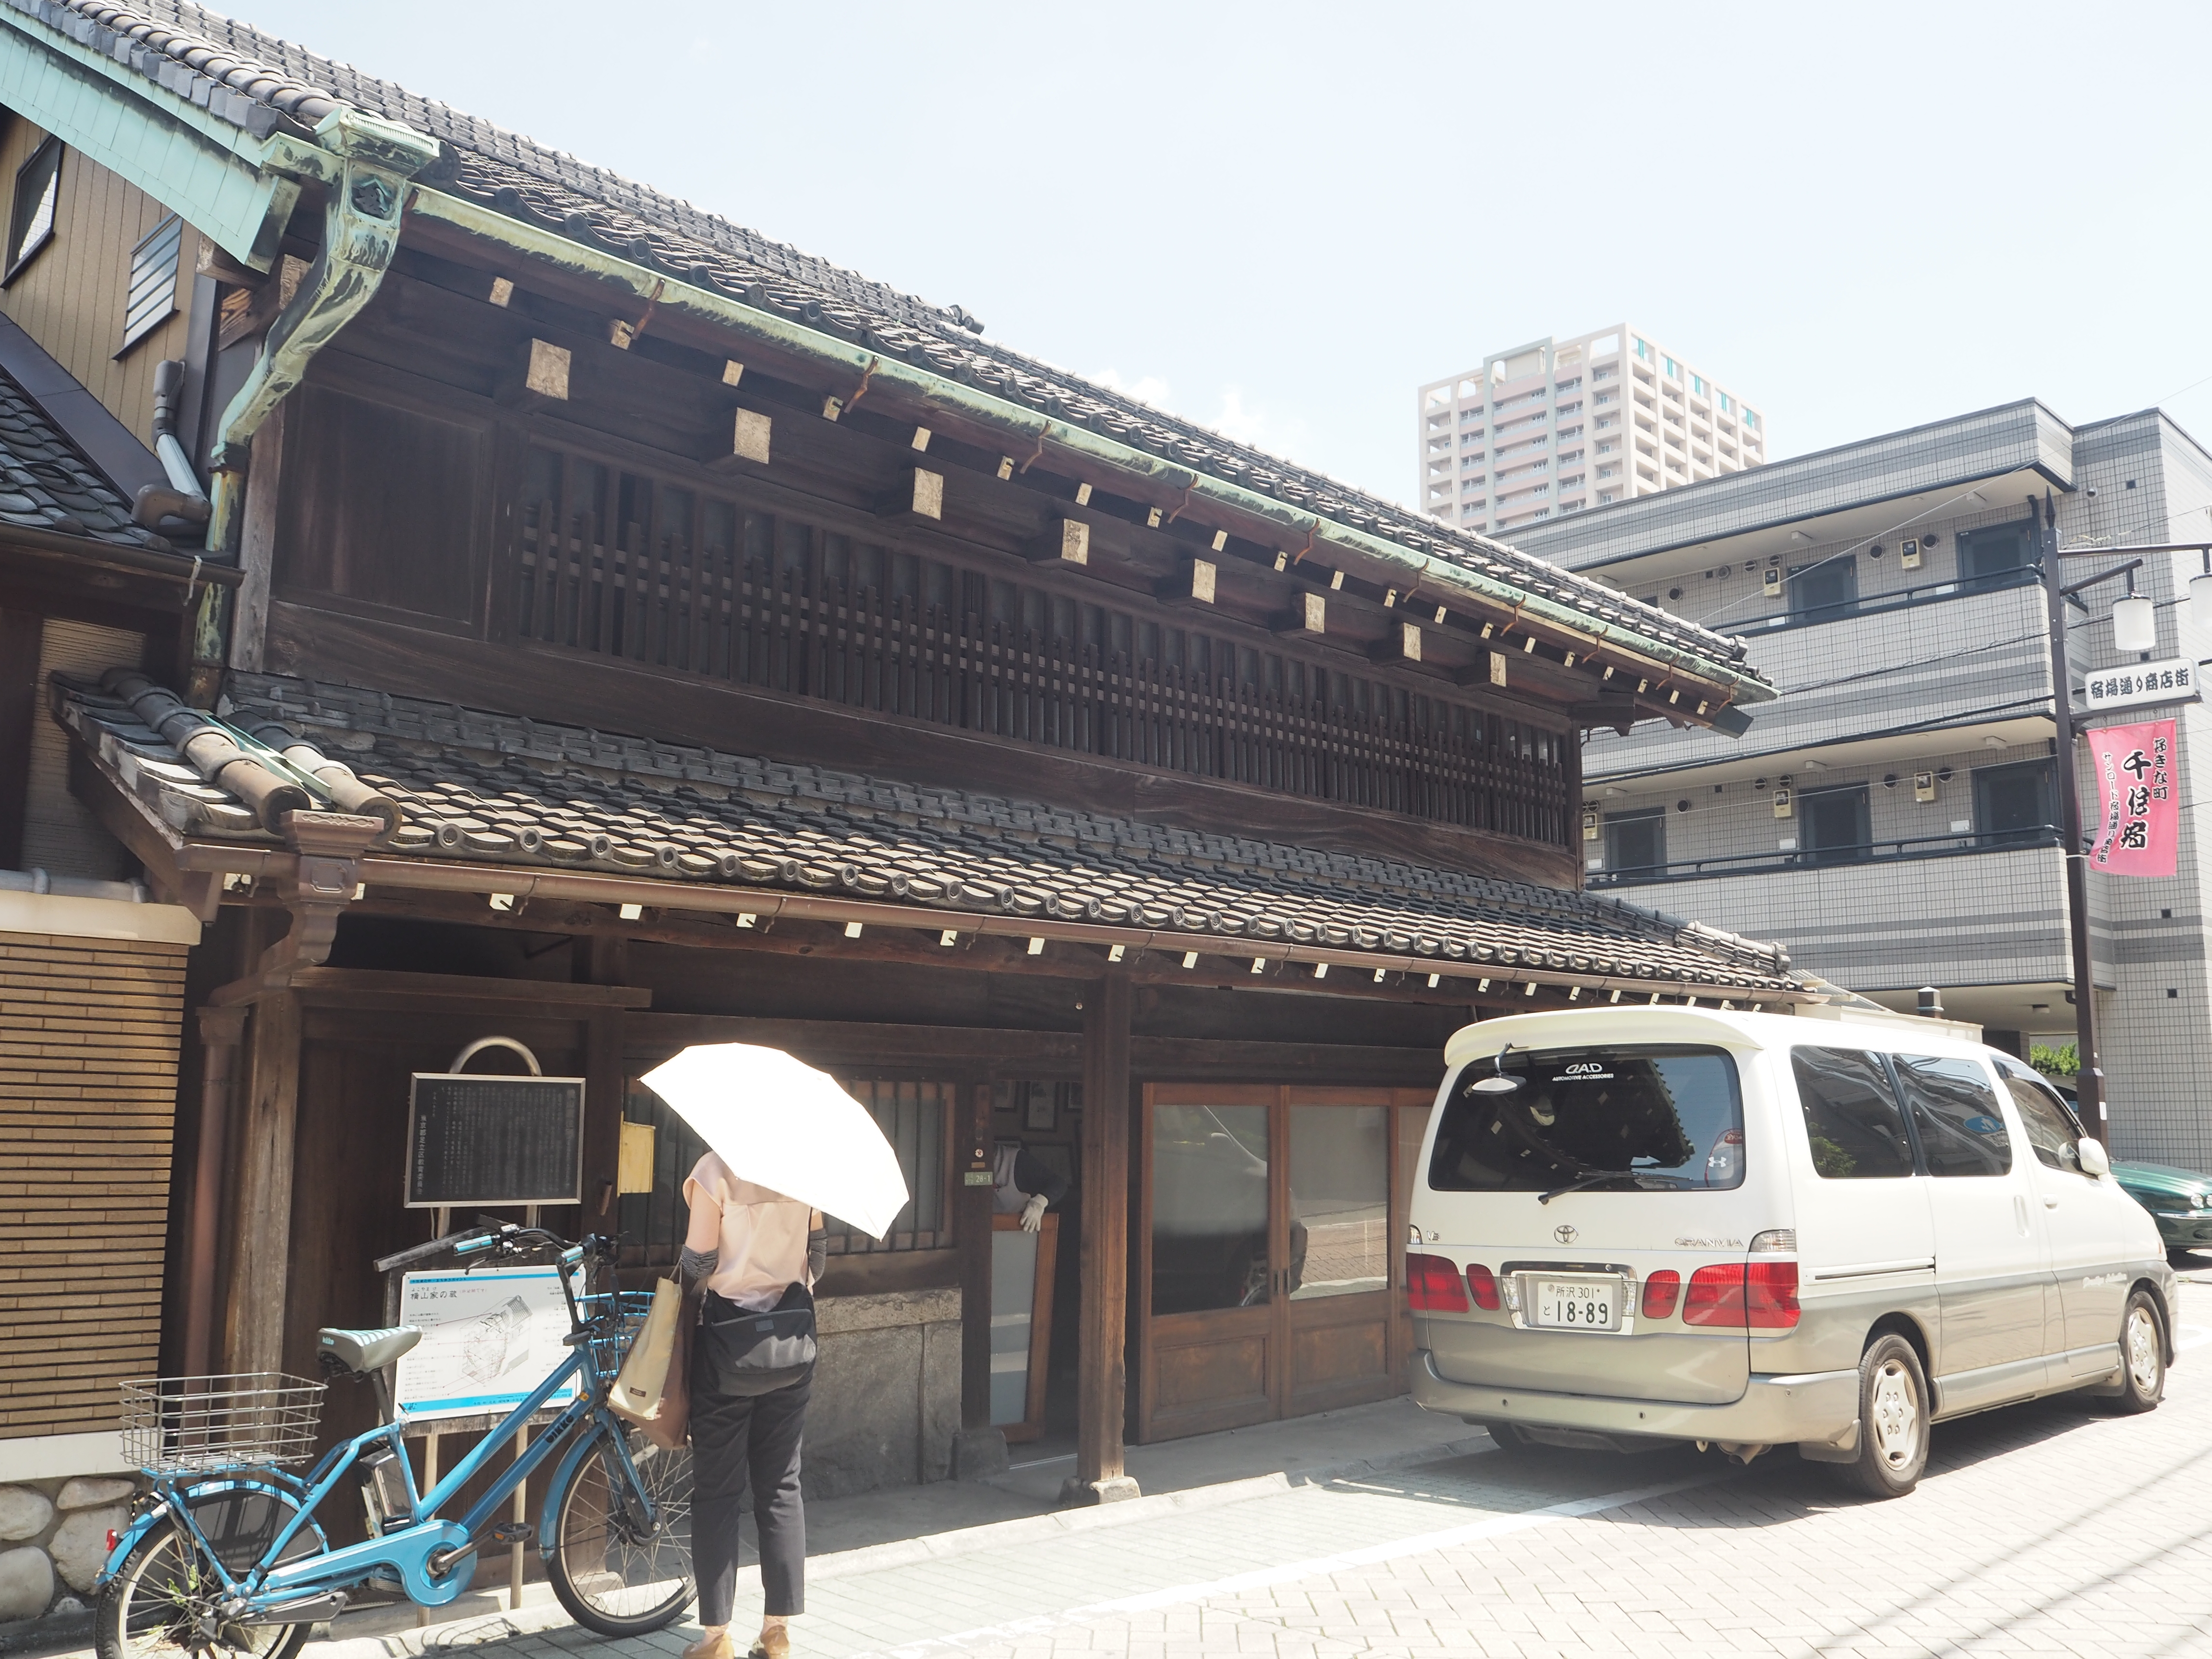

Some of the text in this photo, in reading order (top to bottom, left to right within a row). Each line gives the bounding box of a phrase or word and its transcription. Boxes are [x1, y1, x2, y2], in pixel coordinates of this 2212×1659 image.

[2090, 667, 2189, 700] 宿場通り商店街
[2120, 751, 2152, 849] 千住宿
[975, 1174, 990, 1182] 28-1
[1674, 1237, 1744, 1248] GRANVIA
[410, 1290, 458, 1300] 横山家の蔵
[1556, 1286, 1594, 1299] 所沢 301
[1543, 1300, 1608, 1324] と 18-89
